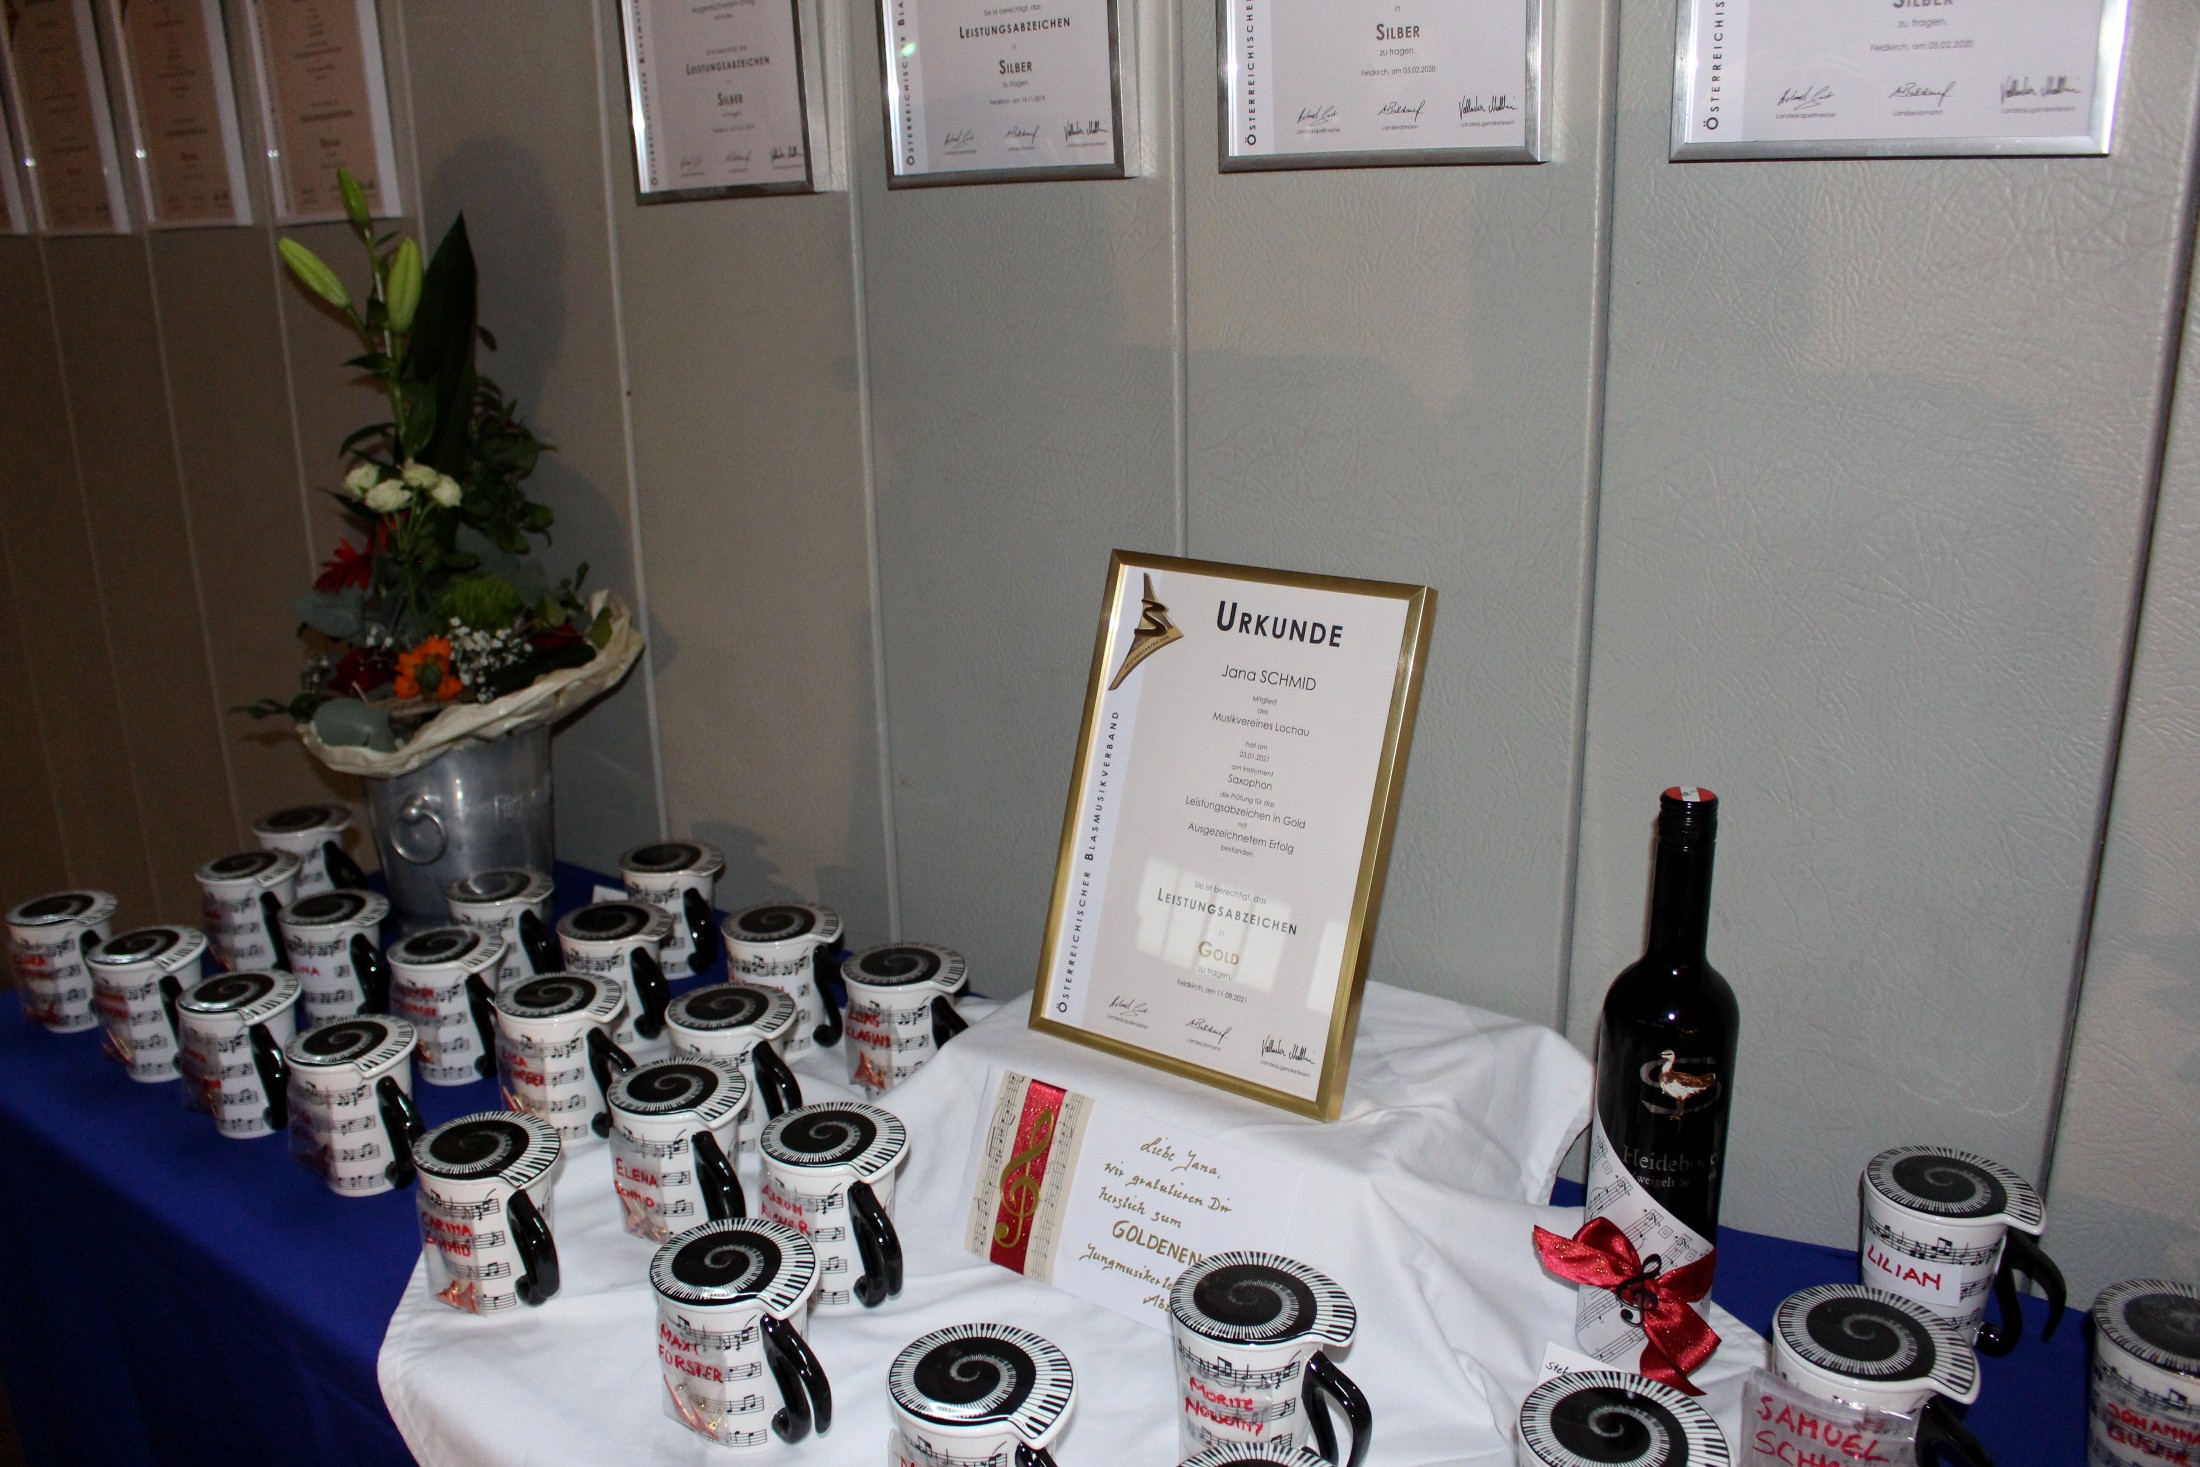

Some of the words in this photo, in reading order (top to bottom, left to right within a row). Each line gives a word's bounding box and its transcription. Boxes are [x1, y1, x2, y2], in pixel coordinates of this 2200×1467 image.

[959, 17, 1071, 39] LEISTUNGSABZEICHEN
[1376, 23, 1420, 41] SILBER
[1379, 49, 1388, 57] zu
[1389, 47, 1416, 58] tragen.
[999, 60, 1033, 75] SILBER
[1244, 0, 1257, 146] ÖSTERREICHISCHE
[1216, 600, 1344, 648] URKUNDE
[1221, 664, 1257, 683] Jana
[1259, 670, 1317, 692] SCHMID
[1252, 695, 1278, 707] Mitglied
[1257, 706, 1269, 716] des
[1212, 711, 1273, 731] Musikvereines
[1275, 722, 1310, 738] Lochau
[1239, 751, 1270, 763] 23.01.2021
[1245, 741, 1256, 750] hat
[1227, 774, 1273, 791] Saxophon
[1242, 765, 1274, 778] Instrument
[1185, 795, 1271, 822] Leistungsabzeichen
[1272, 814, 1282, 824] in
[1283, 816, 1307, 830] Gold
[1220, 791, 1230, 799] die
[1230, 792, 1254, 806] Prüfung
[1254, 797, 1263, 806] für
[1263, 799, 1275, 808] das
[1188, 821, 1267, 848] Ausgezeichnetem
[1268, 839, 1295, 855] Erfolg
[1220, 844, 1255, 858] bestanden.
[1055, 870, 1092, 1013] ÖSTERREICHISCHER
[1084, 711, 1119, 862] BLASMUSIKVERBAND
[1194, 880, 1205, 890] Sie
[1205, 883, 1214, 892] ist
[1213, 884, 1253, 902] berechtigt,
[1253, 894, 1267, 905] das
[1157, 887, 1298, 936] LEISTUNGSABZEICHEN
[1218, 929, 1226, 937] in
[1197, 940, 1240, 966] GOLD
[1197, 965, 1206, 975] zu
[1207, 967, 1233, 981] tragen.
[1176, 978, 1204, 992] Feldkirch,
[1205, 987, 1216, 996] am
[1217, 987, 1248, 1004] 11.08.2021
[1139, 1136, 1176, 1162] Liebe
[1170, 1149, 1222, 1180] Jana,
[614, 1157, 659, 1189] ELENA
[1124, 1173, 1204, 1207] gratulieren
[1207, 1196, 1233, 1214] Dir
[1098, 1186, 1146, 1216] herzlich
[1150, 1210, 1182, 1229] zum
[1111, 1219, 1202, 1267] GOLDENEN
[1866, 1245, 1943, 1292] LILIAN
[1756, 1395, 1890, 1463] SAMUEL
